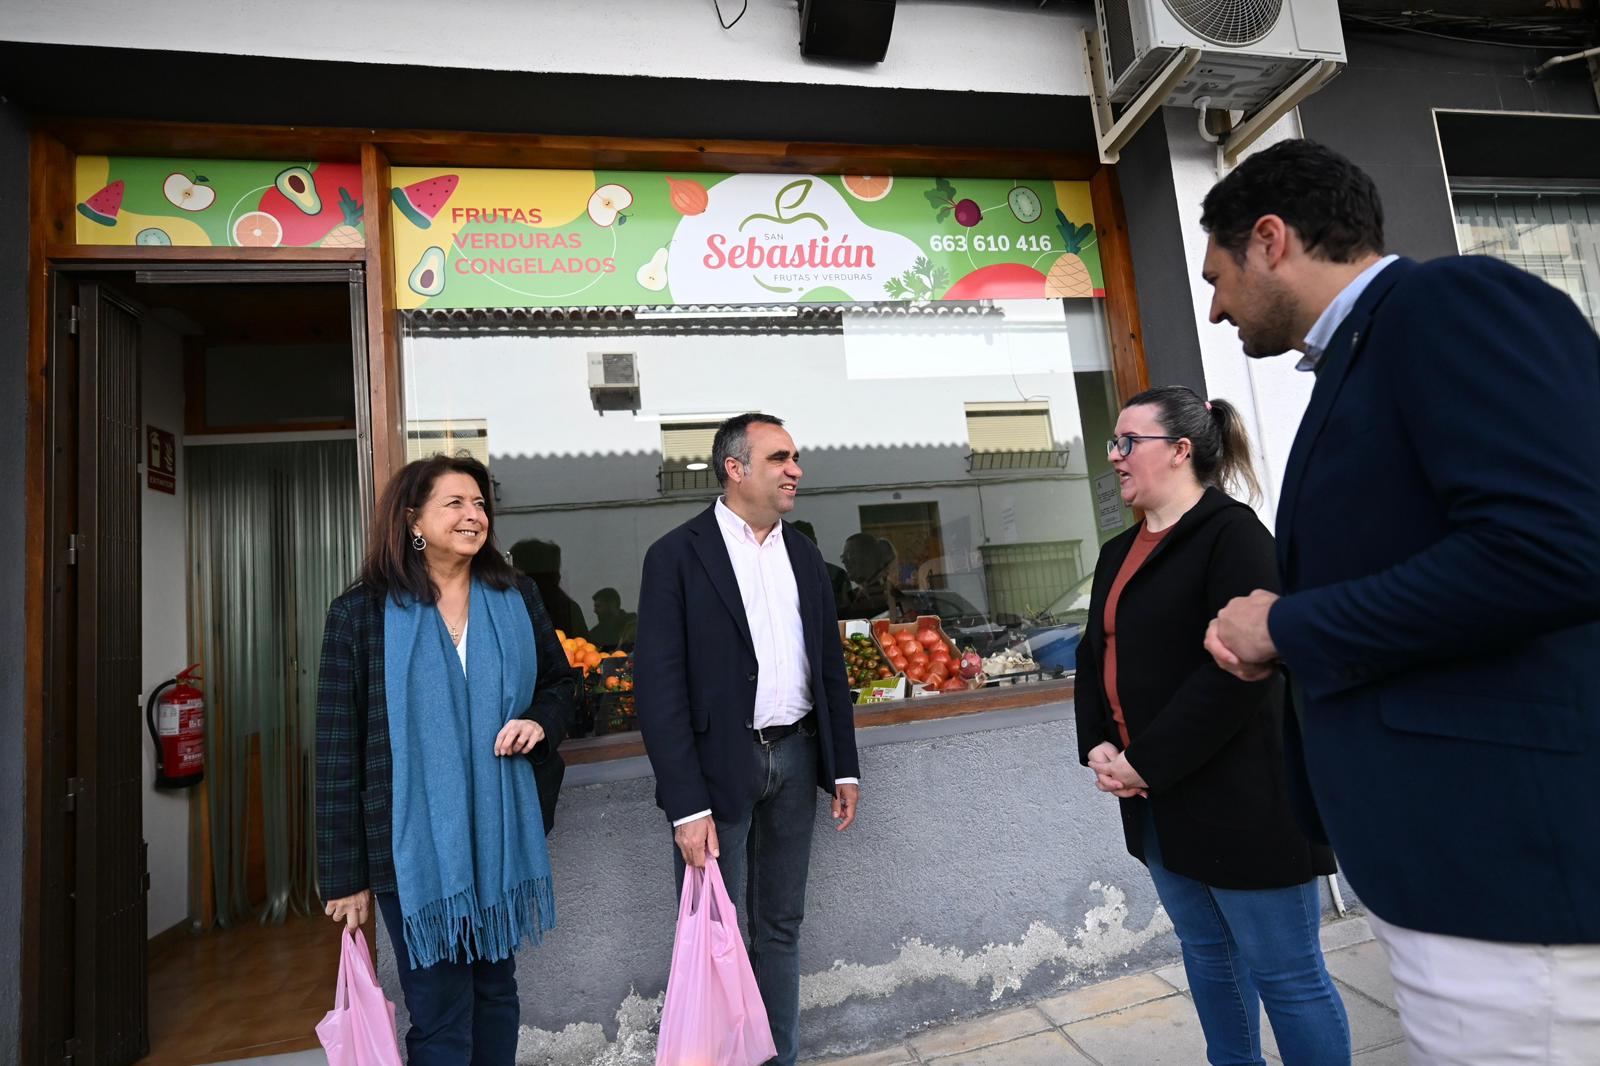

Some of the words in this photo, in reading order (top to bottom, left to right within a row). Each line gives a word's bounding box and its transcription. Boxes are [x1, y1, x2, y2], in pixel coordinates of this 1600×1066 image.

[451, 207, 543, 225] FRUTAS
[452, 232, 582, 250] VERDURAS
[764, 233, 784, 241] SAN
[930, 234, 968, 252] 663
[973, 234, 1010, 252] 610
[1015, 234, 1052, 252] 416
[703, 233, 876, 270] Sebastián
[454, 257, 616, 275] CONGELADOS
[774, 274, 810, 282] FRUTAS
[823, 273, 872, 281] VERDURAS
